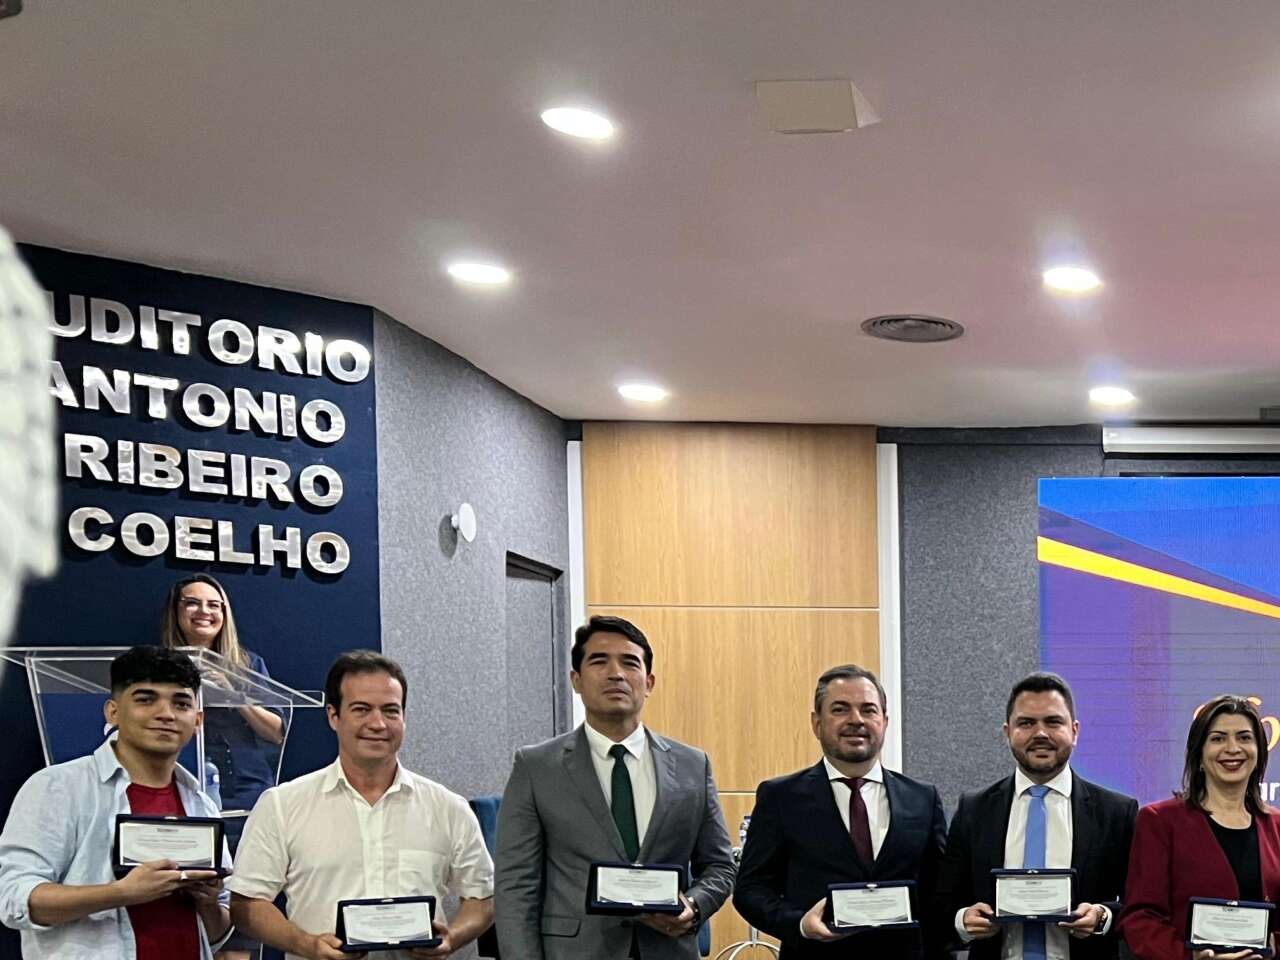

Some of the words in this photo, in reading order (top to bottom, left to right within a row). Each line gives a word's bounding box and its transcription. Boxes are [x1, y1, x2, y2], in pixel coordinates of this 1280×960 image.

[50, 291, 371, 383] UDITORIO
[49, 360, 346, 443] ANTONIO
[64, 433, 344, 507] RIBEIRO
[68, 506, 350, 574] COELHO
